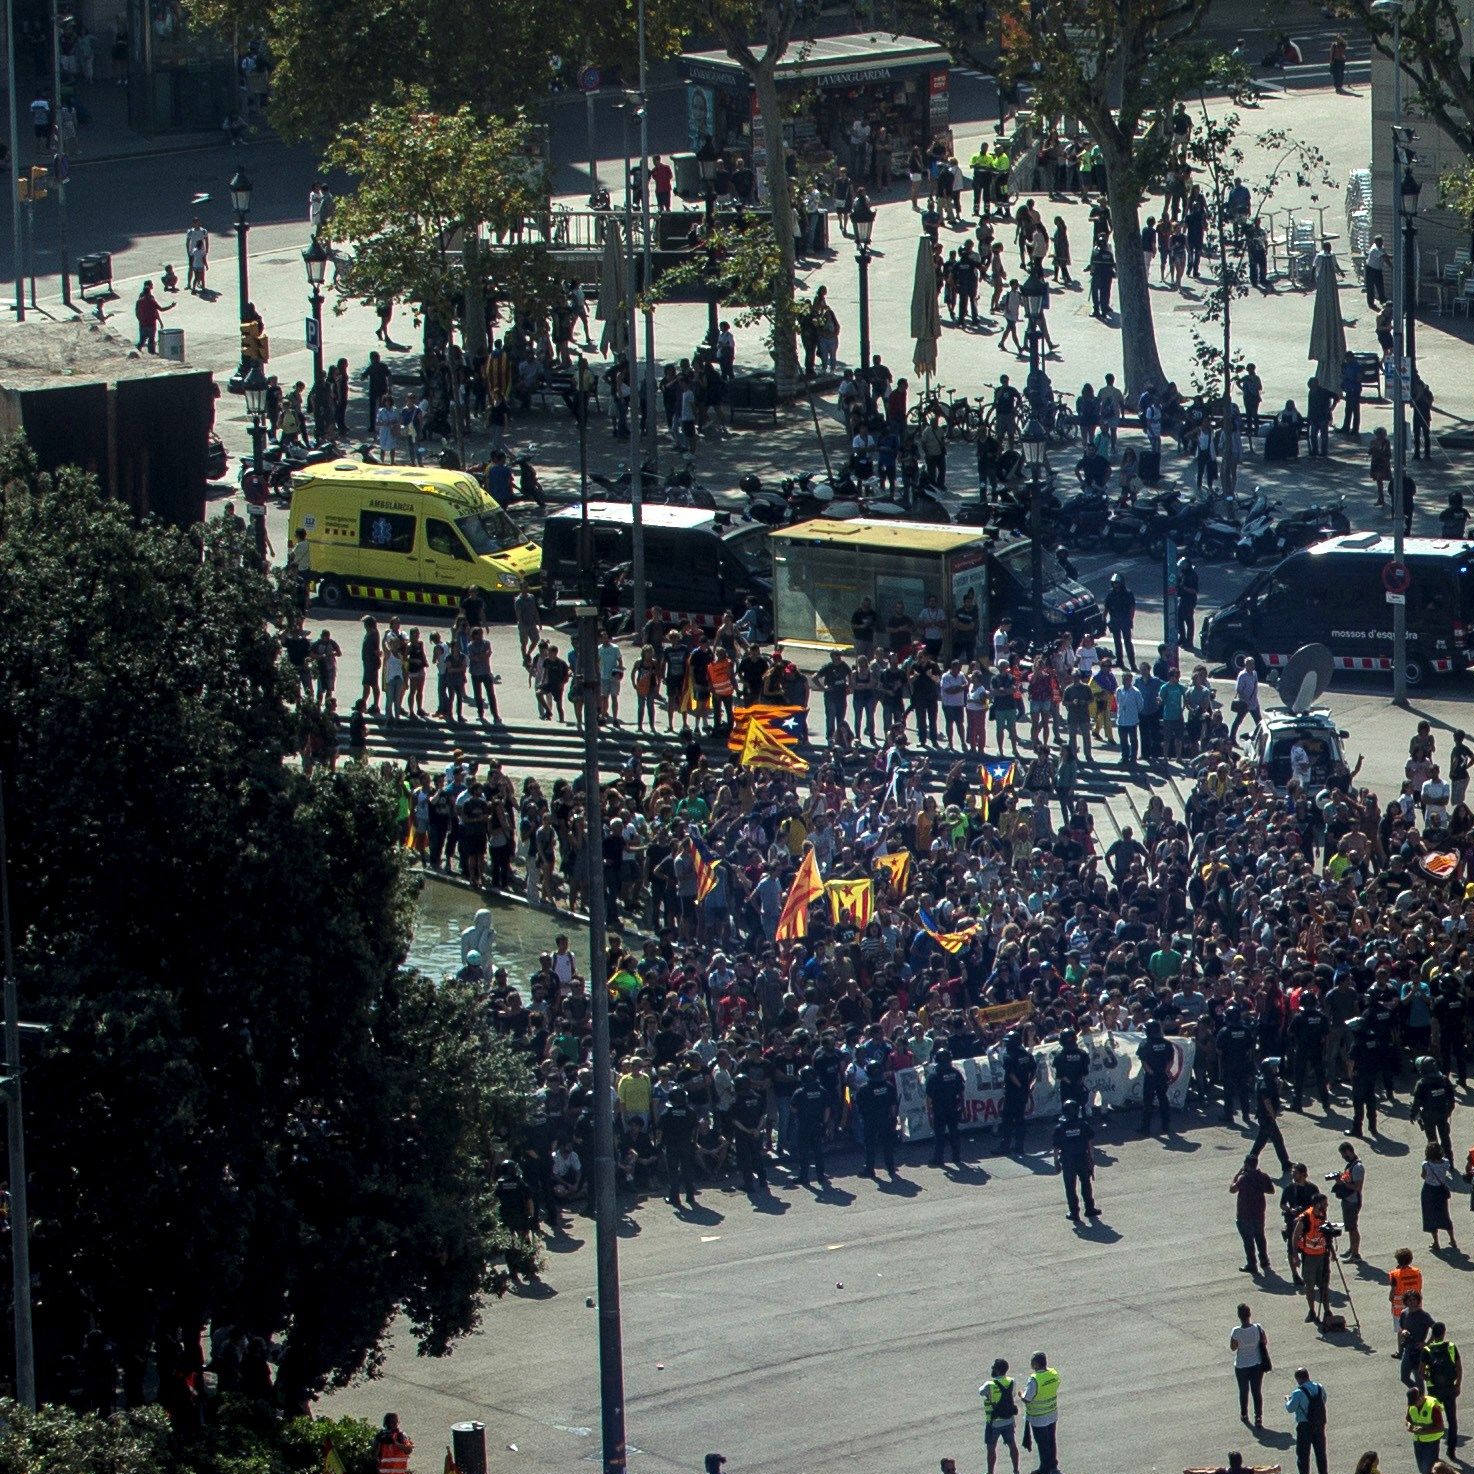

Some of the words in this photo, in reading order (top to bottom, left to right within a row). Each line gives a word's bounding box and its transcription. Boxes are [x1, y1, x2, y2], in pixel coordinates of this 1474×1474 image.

[817, 75, 829, 86] LA
[829, 68, 891, 84] VANGUARDIA
[308, 321, 316, 342] P
[1331, 630, 1366, 638] mossos
